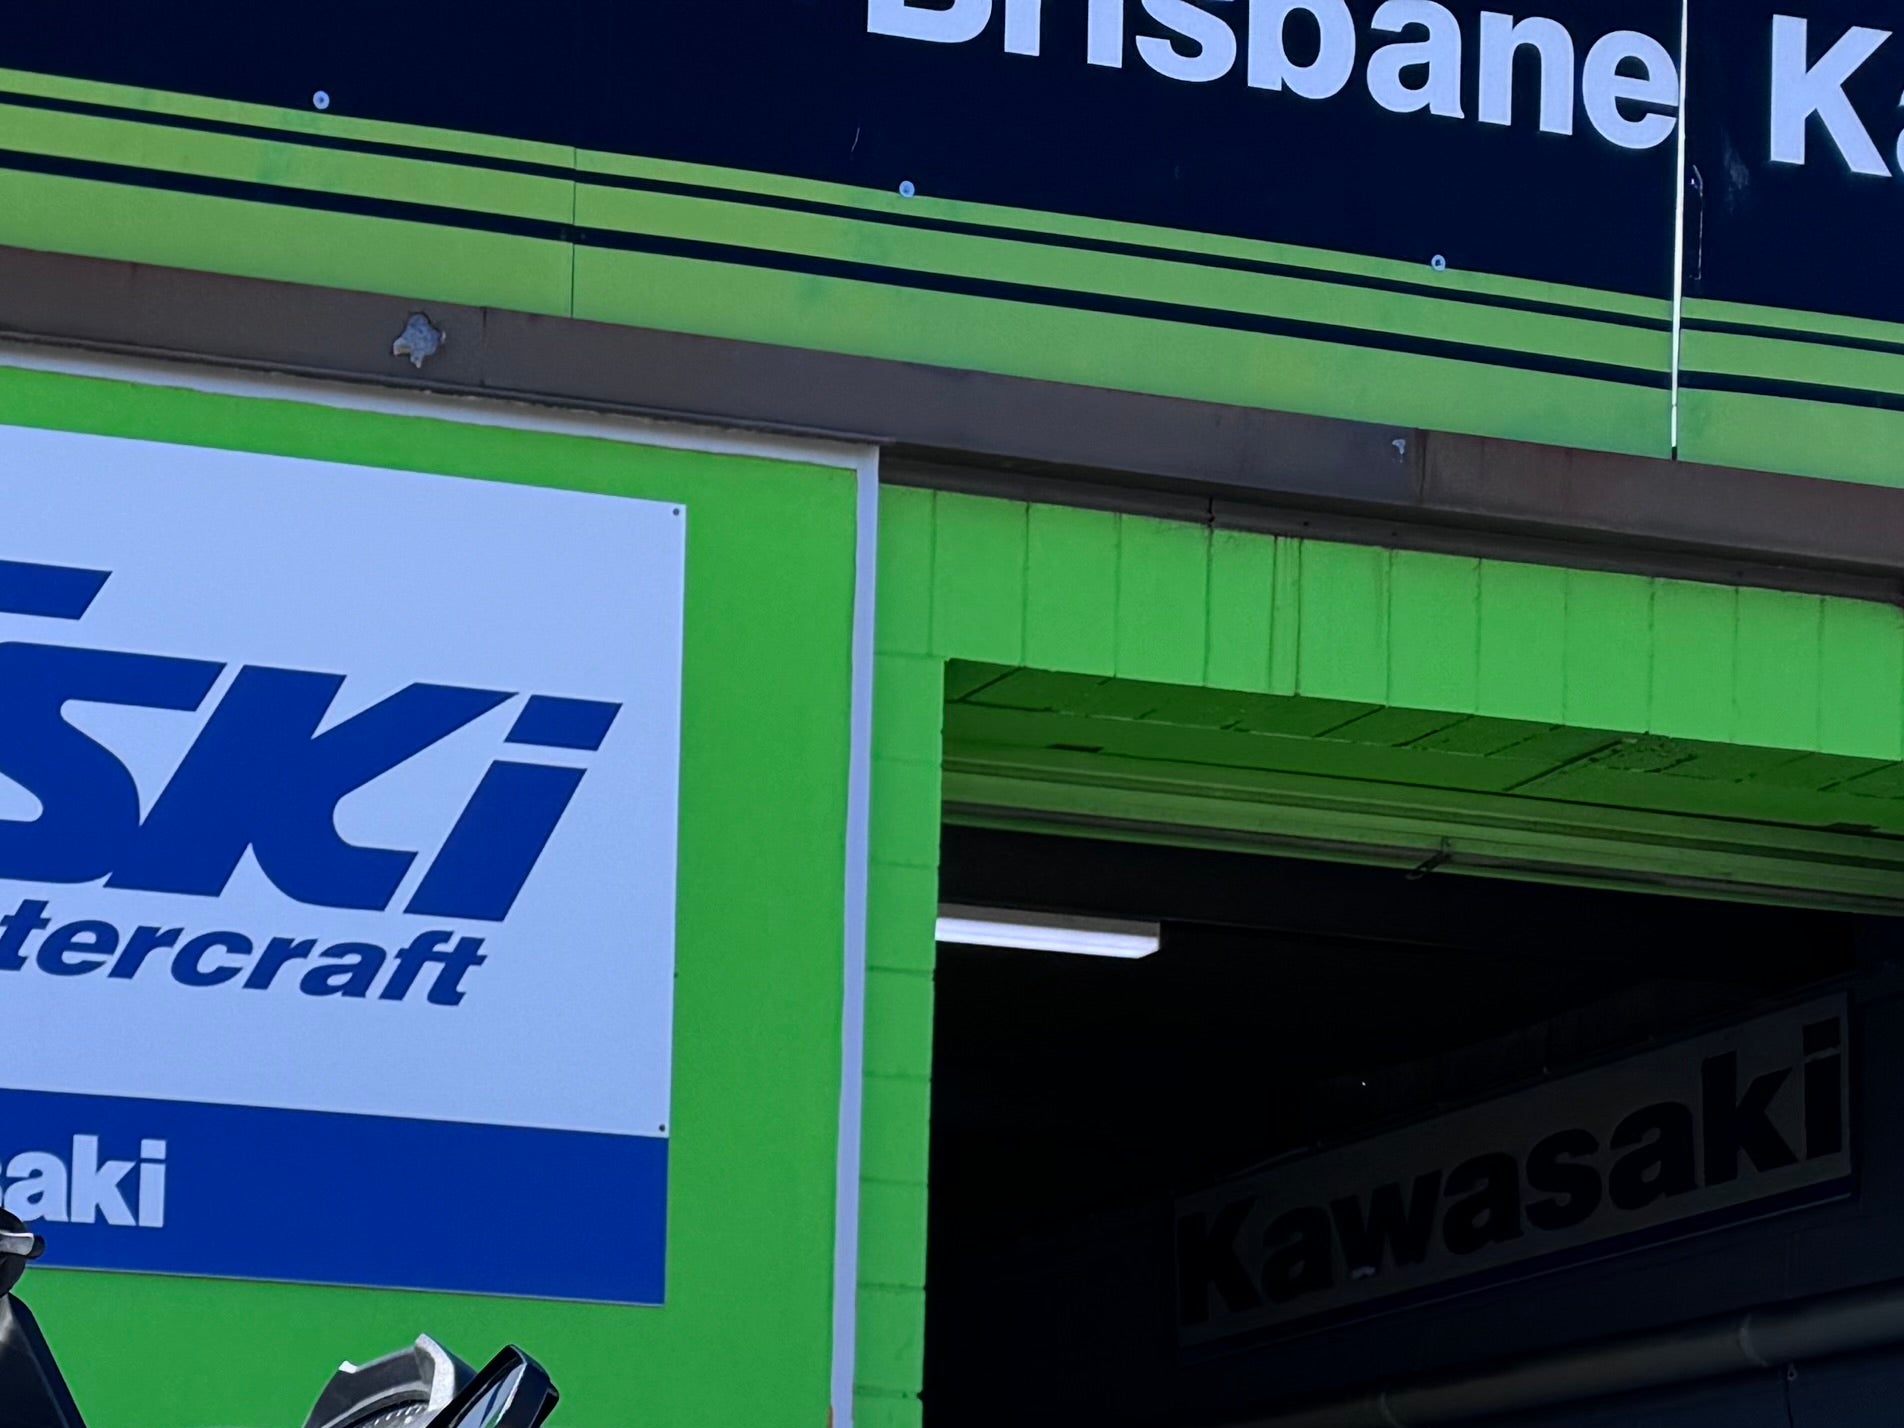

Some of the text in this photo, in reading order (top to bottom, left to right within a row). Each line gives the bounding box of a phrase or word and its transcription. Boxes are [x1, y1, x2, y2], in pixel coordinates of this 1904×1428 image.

[866, 0, 1904, 177] sbane K
[1176, 1016, 1842, 1324] Kawasaki
